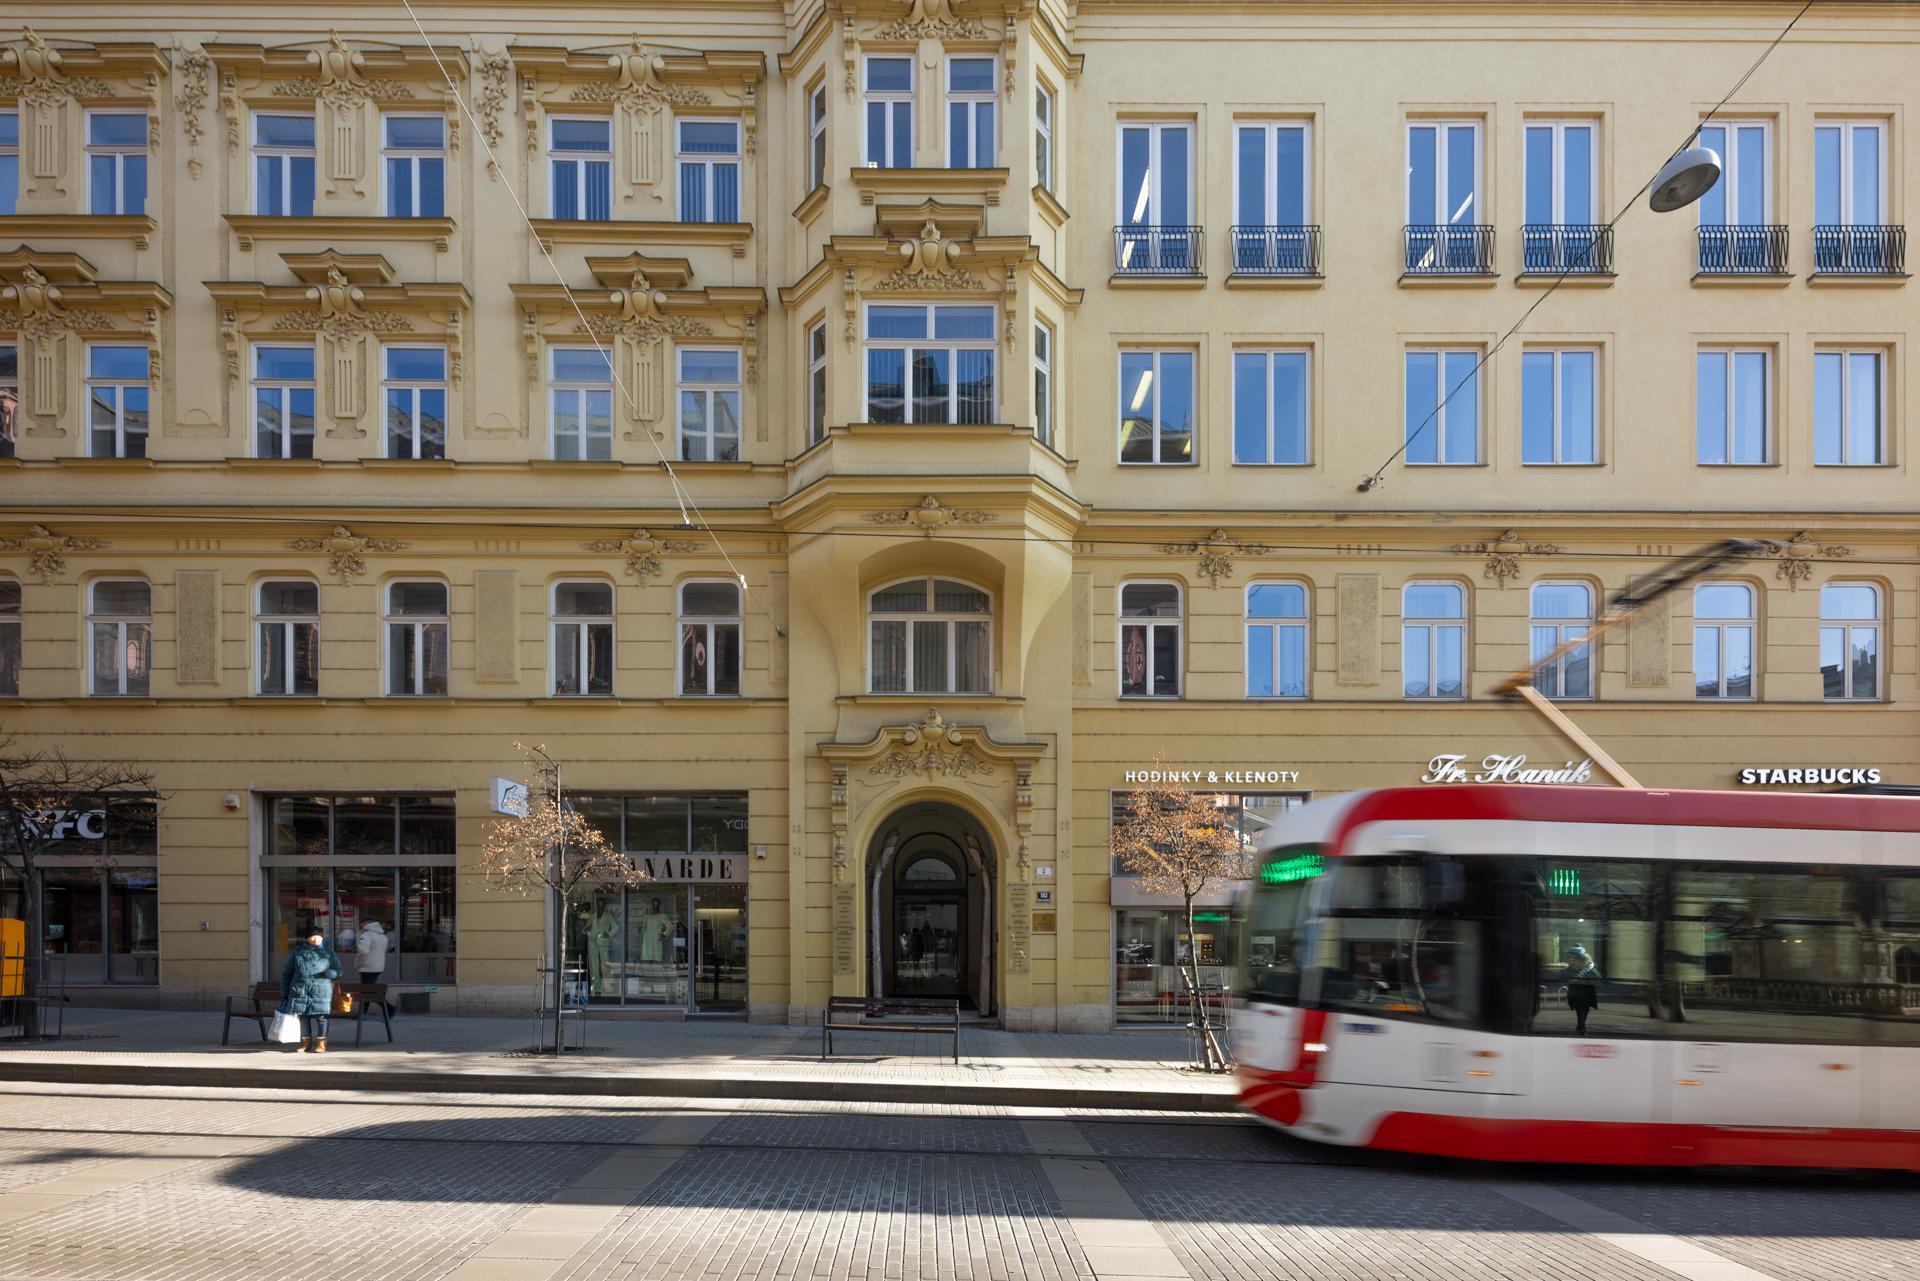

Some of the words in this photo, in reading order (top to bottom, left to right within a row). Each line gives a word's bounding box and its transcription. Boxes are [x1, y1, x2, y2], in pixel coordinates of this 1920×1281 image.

[1125, 771, 1201, 783] HODINKY
[1207, 771, 1218, 783] &
[1225, 771, 1299, 783] KLENOTY
[1421, 754, 1468, 783] Fr.
[1474, 754, 1593, 784] Hanák
[1742, 768, 1881, 784] STARBUCKS
